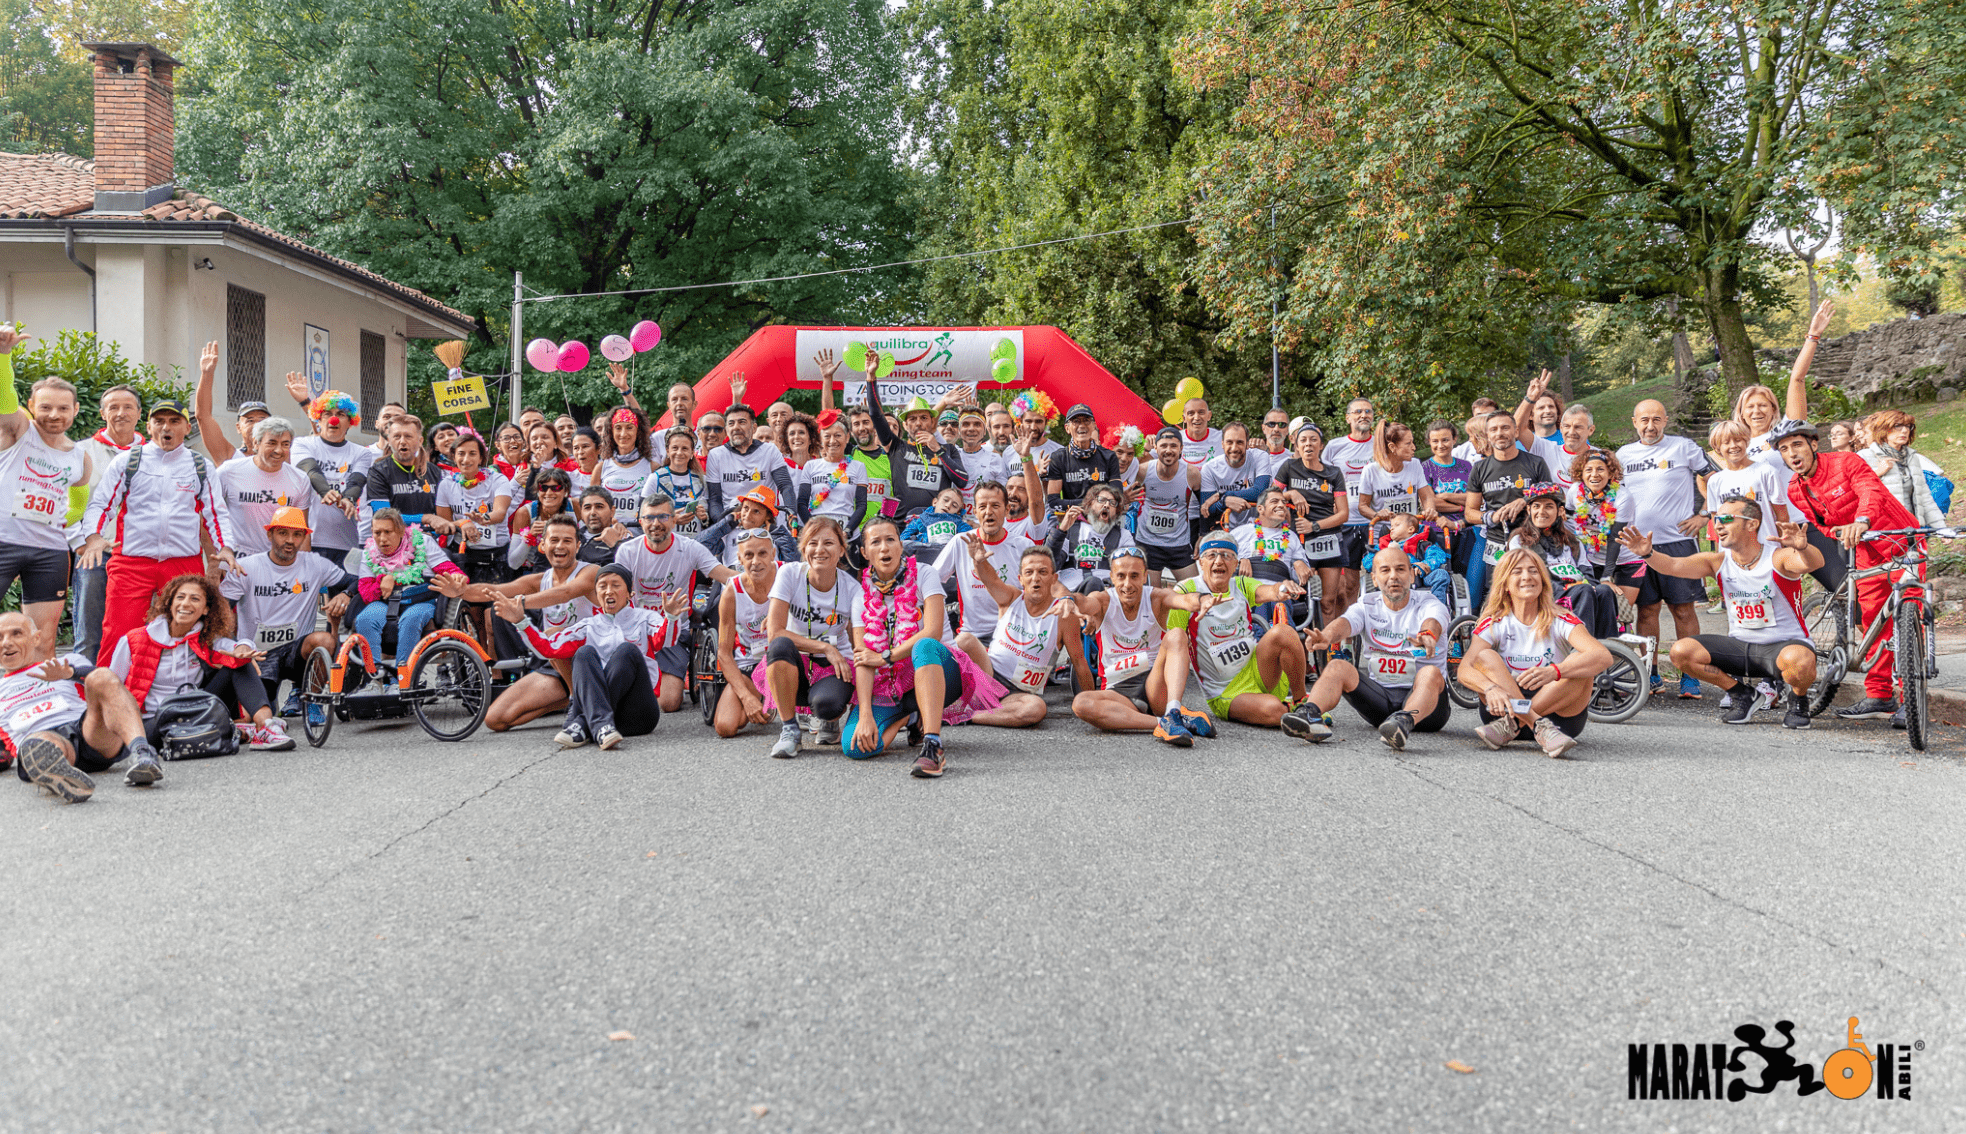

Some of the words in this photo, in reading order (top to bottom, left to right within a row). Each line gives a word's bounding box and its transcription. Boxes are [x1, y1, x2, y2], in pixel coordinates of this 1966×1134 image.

[919, 369, 953, 378] team
[446, 383, 473, 395] FINE
[443, 395, 483, 408] CORSA
[910, 469, 938, 484] 1825
[23, 494, 55, 516] 330
[1389, 502, 1412, 514] 1931
[929, 521, 956, 536] 1333
[1150, 515, 1175, 528] 1309
[1310, 539, 1334, 553] 1911
[1735, 604, 1765, 620] 399
[260, 627, 294, 643] 1826
[1217, 641, 1251, 666] 1139
[1378, 658, 1407, 674] 292
[1021, 669, 1045, 686] 207
